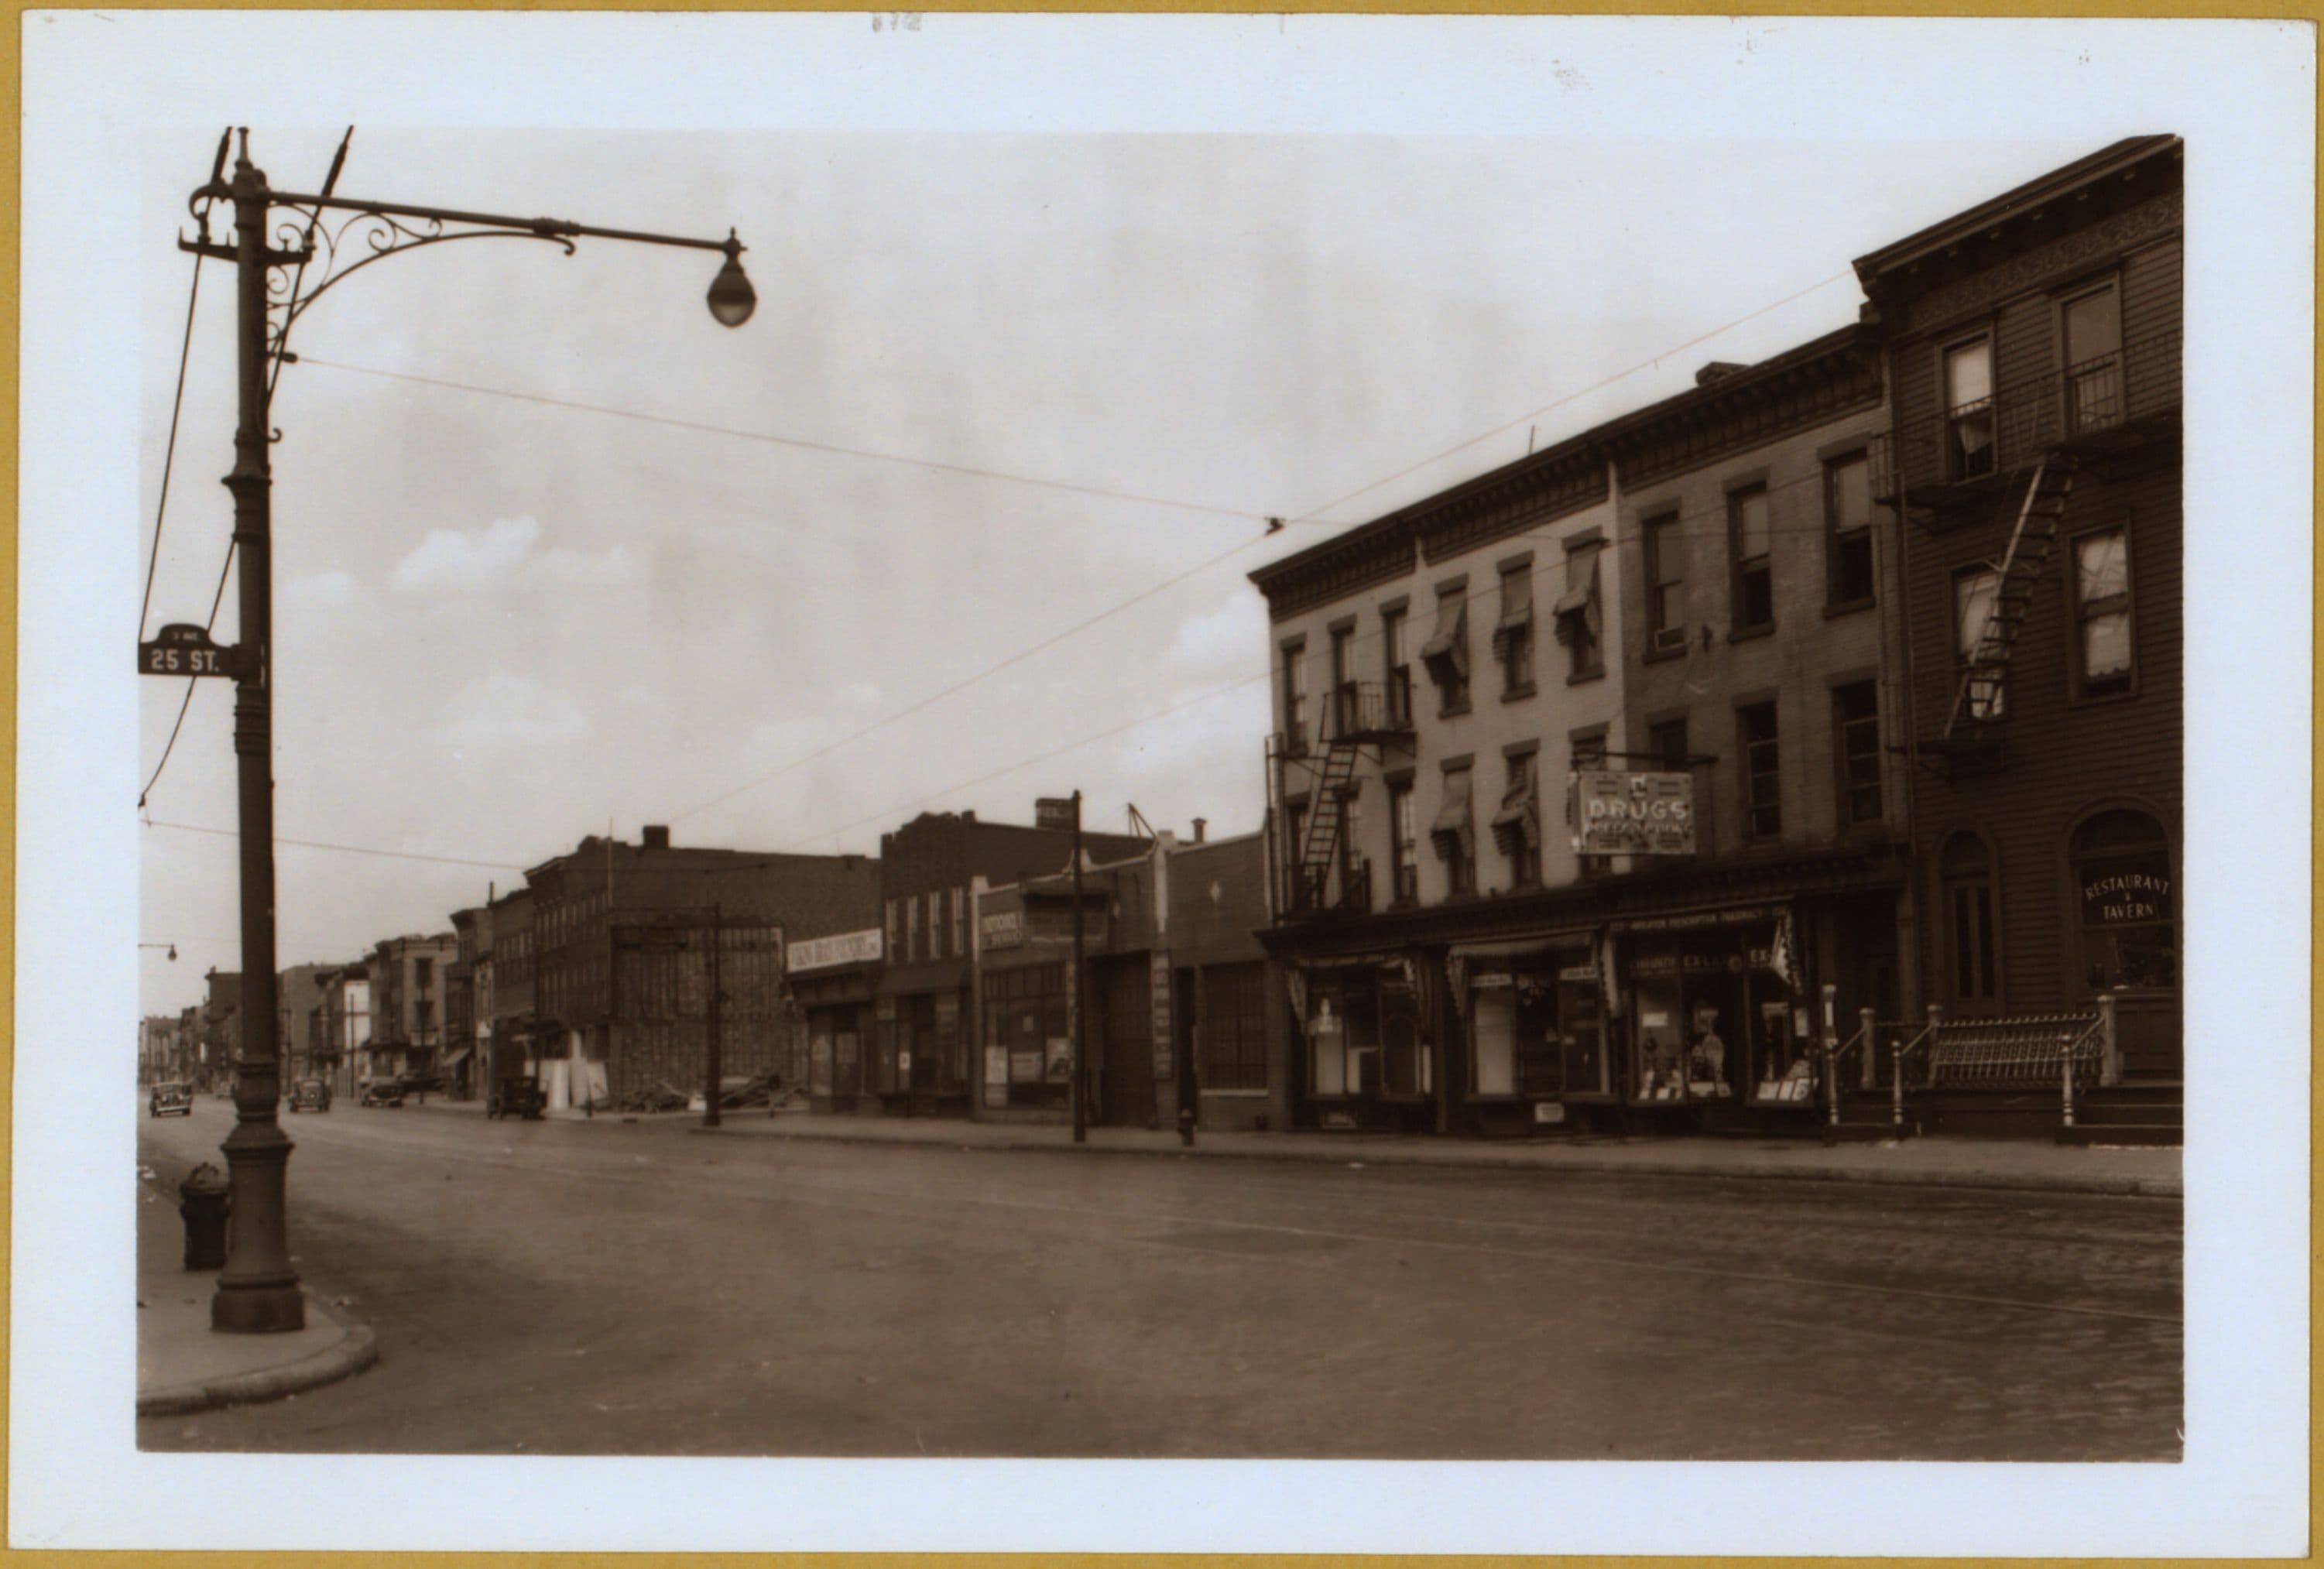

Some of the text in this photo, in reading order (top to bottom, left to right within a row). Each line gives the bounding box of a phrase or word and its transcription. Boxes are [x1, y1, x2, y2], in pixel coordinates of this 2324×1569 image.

[151, 648, 220, 672] 25 ST.
[1589, 799, 1688, 820] DRUGS
[2085, 874, 2170, 901] RESTAURANT
[2103, 903, 2154, 920] TAVERN
